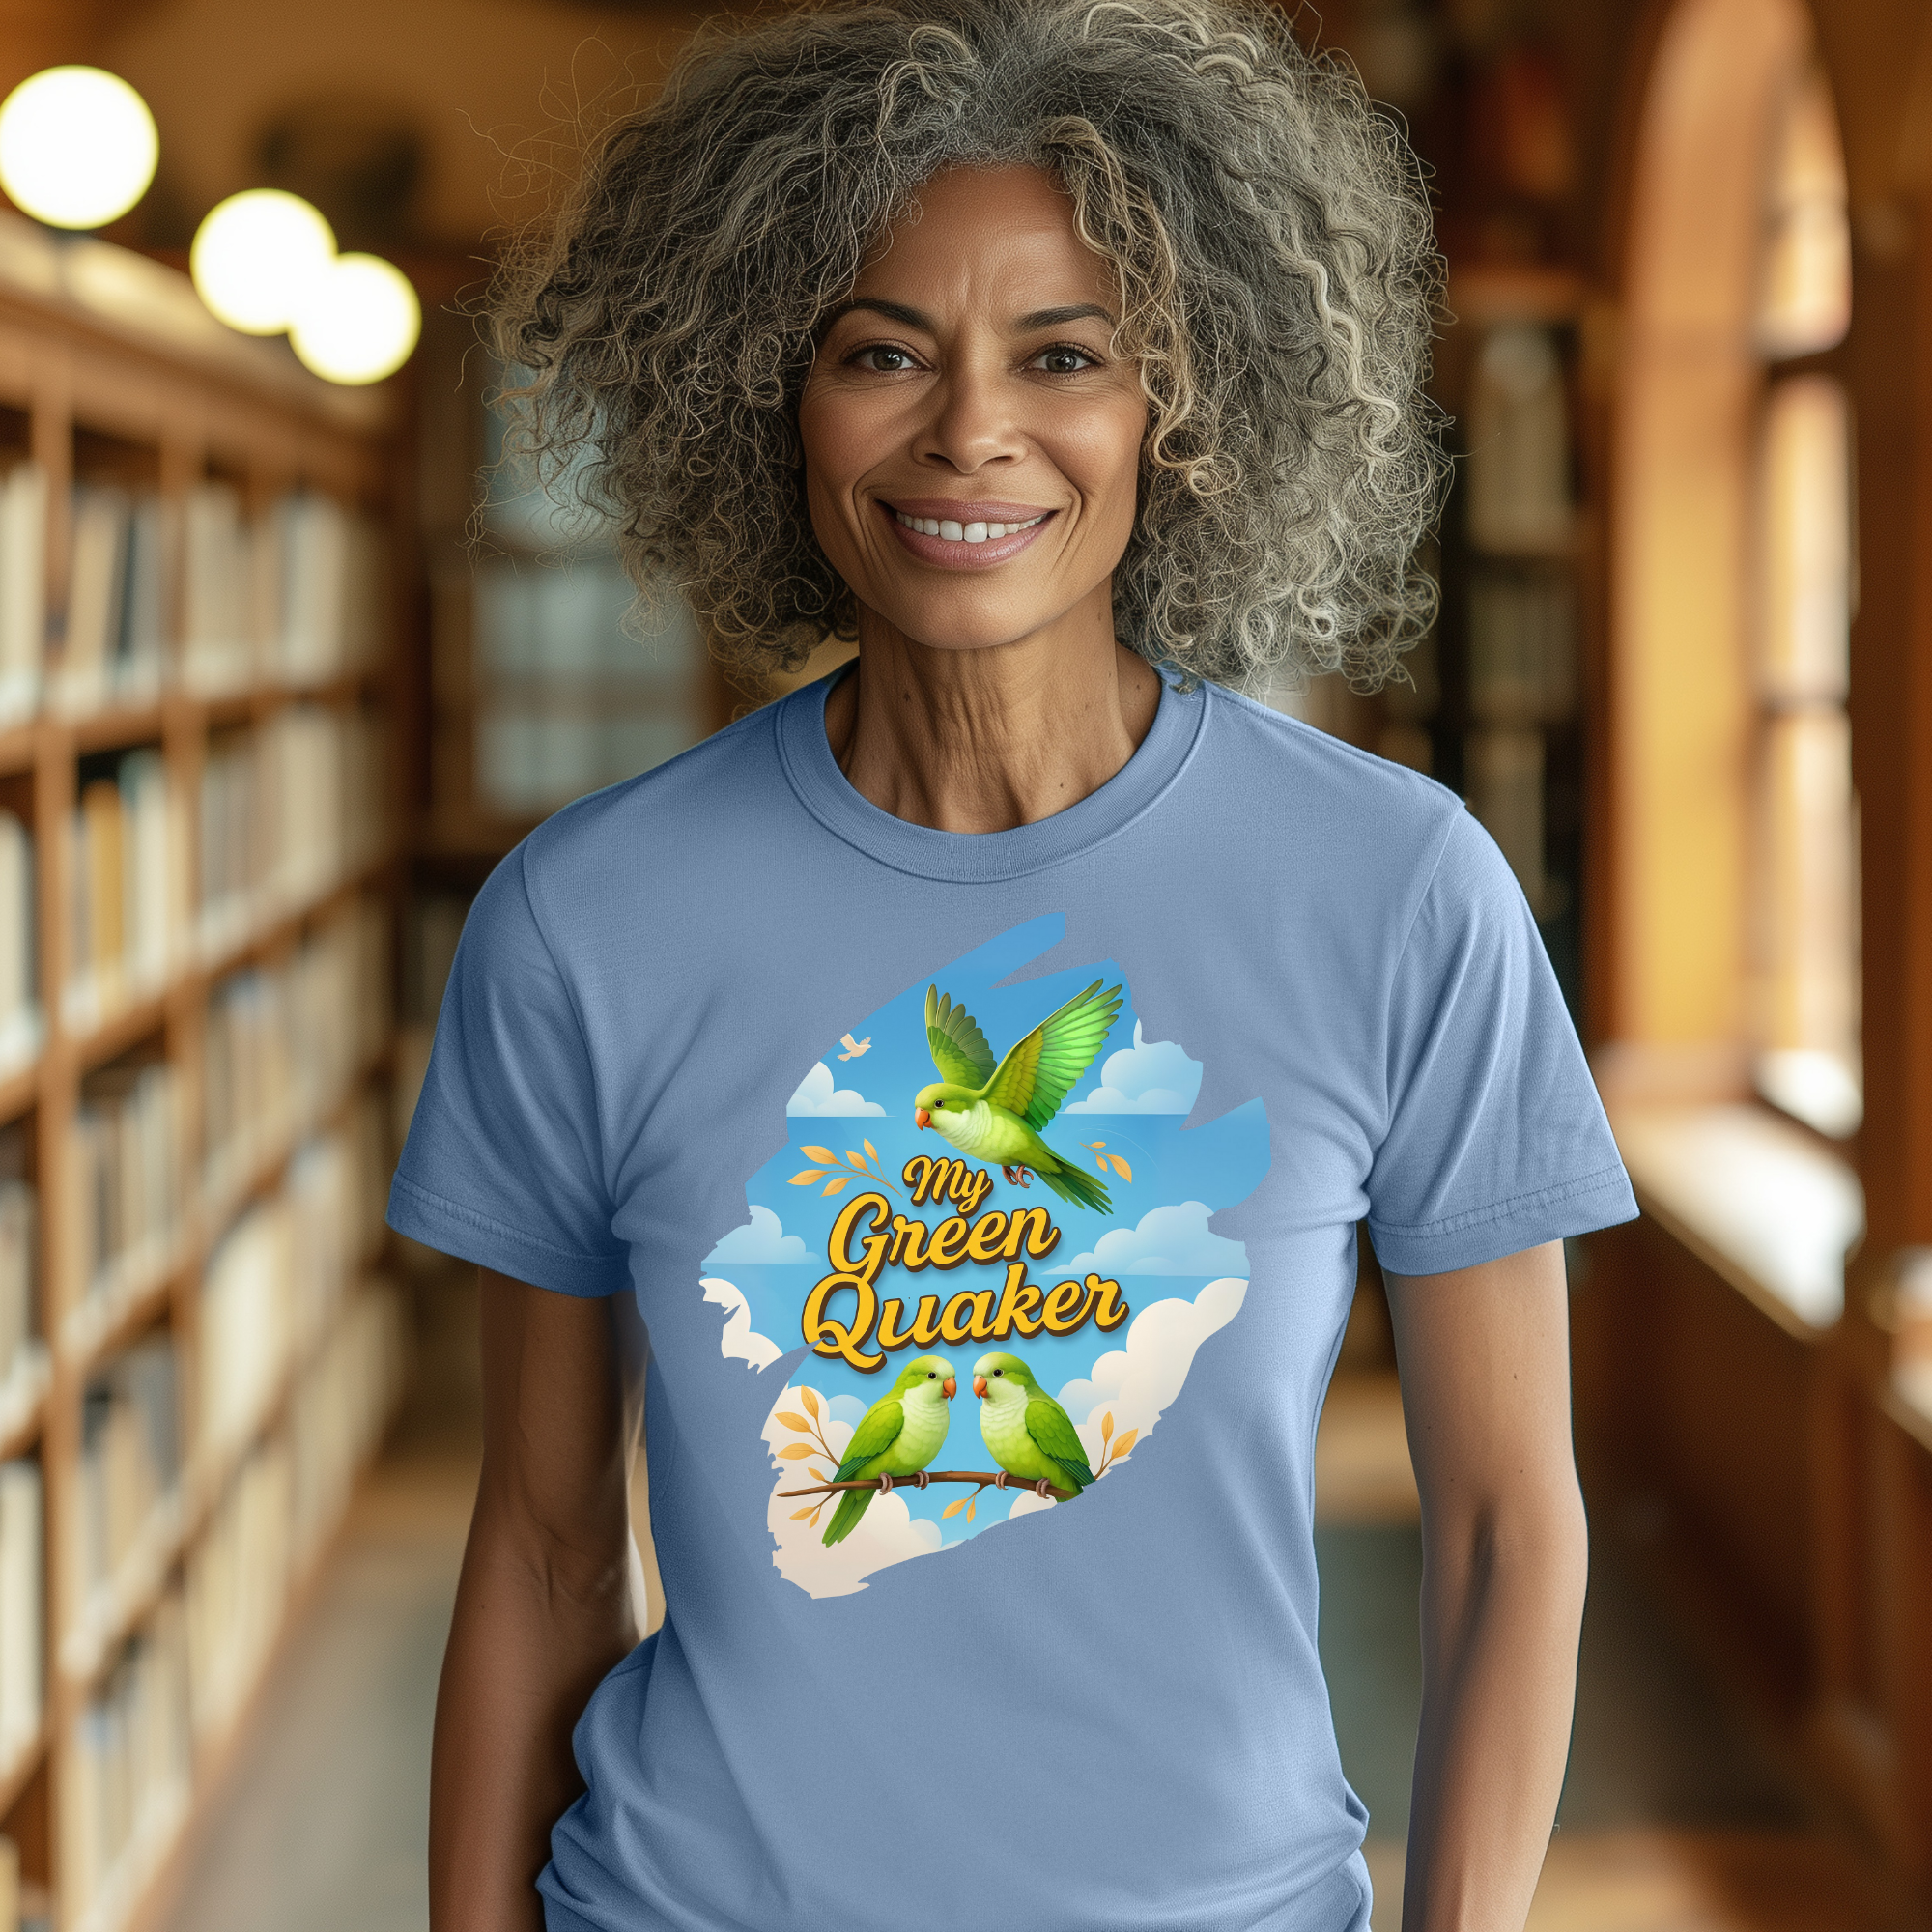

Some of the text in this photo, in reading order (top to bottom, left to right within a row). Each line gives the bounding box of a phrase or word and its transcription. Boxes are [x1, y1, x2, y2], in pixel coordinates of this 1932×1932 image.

[902, 1154, 994, 1216] My
[828, 1191, 1062, 1285] Green
[801, 1262, 1130, 1374] Quaker
